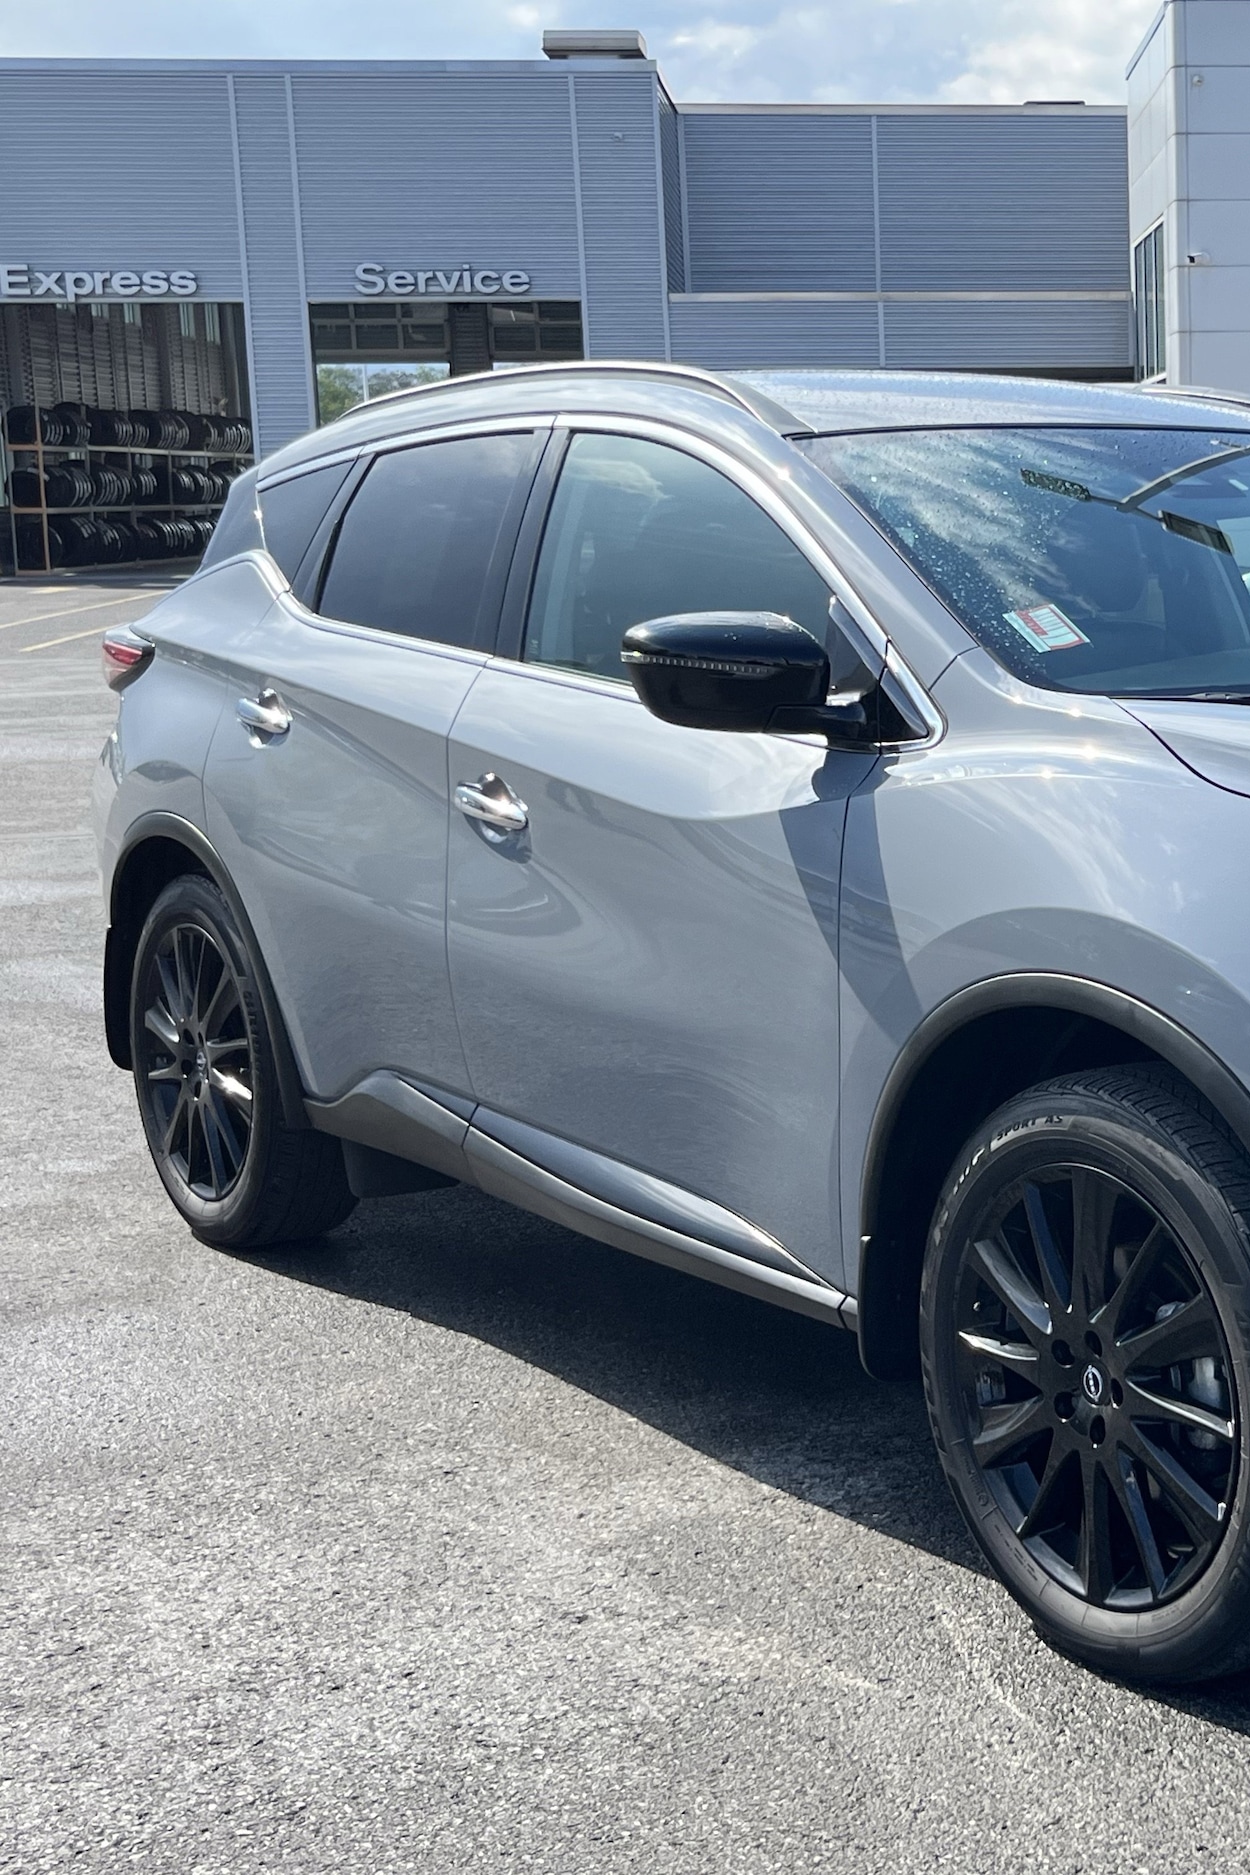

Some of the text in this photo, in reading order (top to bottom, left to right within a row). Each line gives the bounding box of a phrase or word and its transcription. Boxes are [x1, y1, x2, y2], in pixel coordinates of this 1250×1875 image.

[0, 264, 198, 302] Express
[354, 263, 531, 295] Service
[996, 1118, 1038, 1141] SPORT
